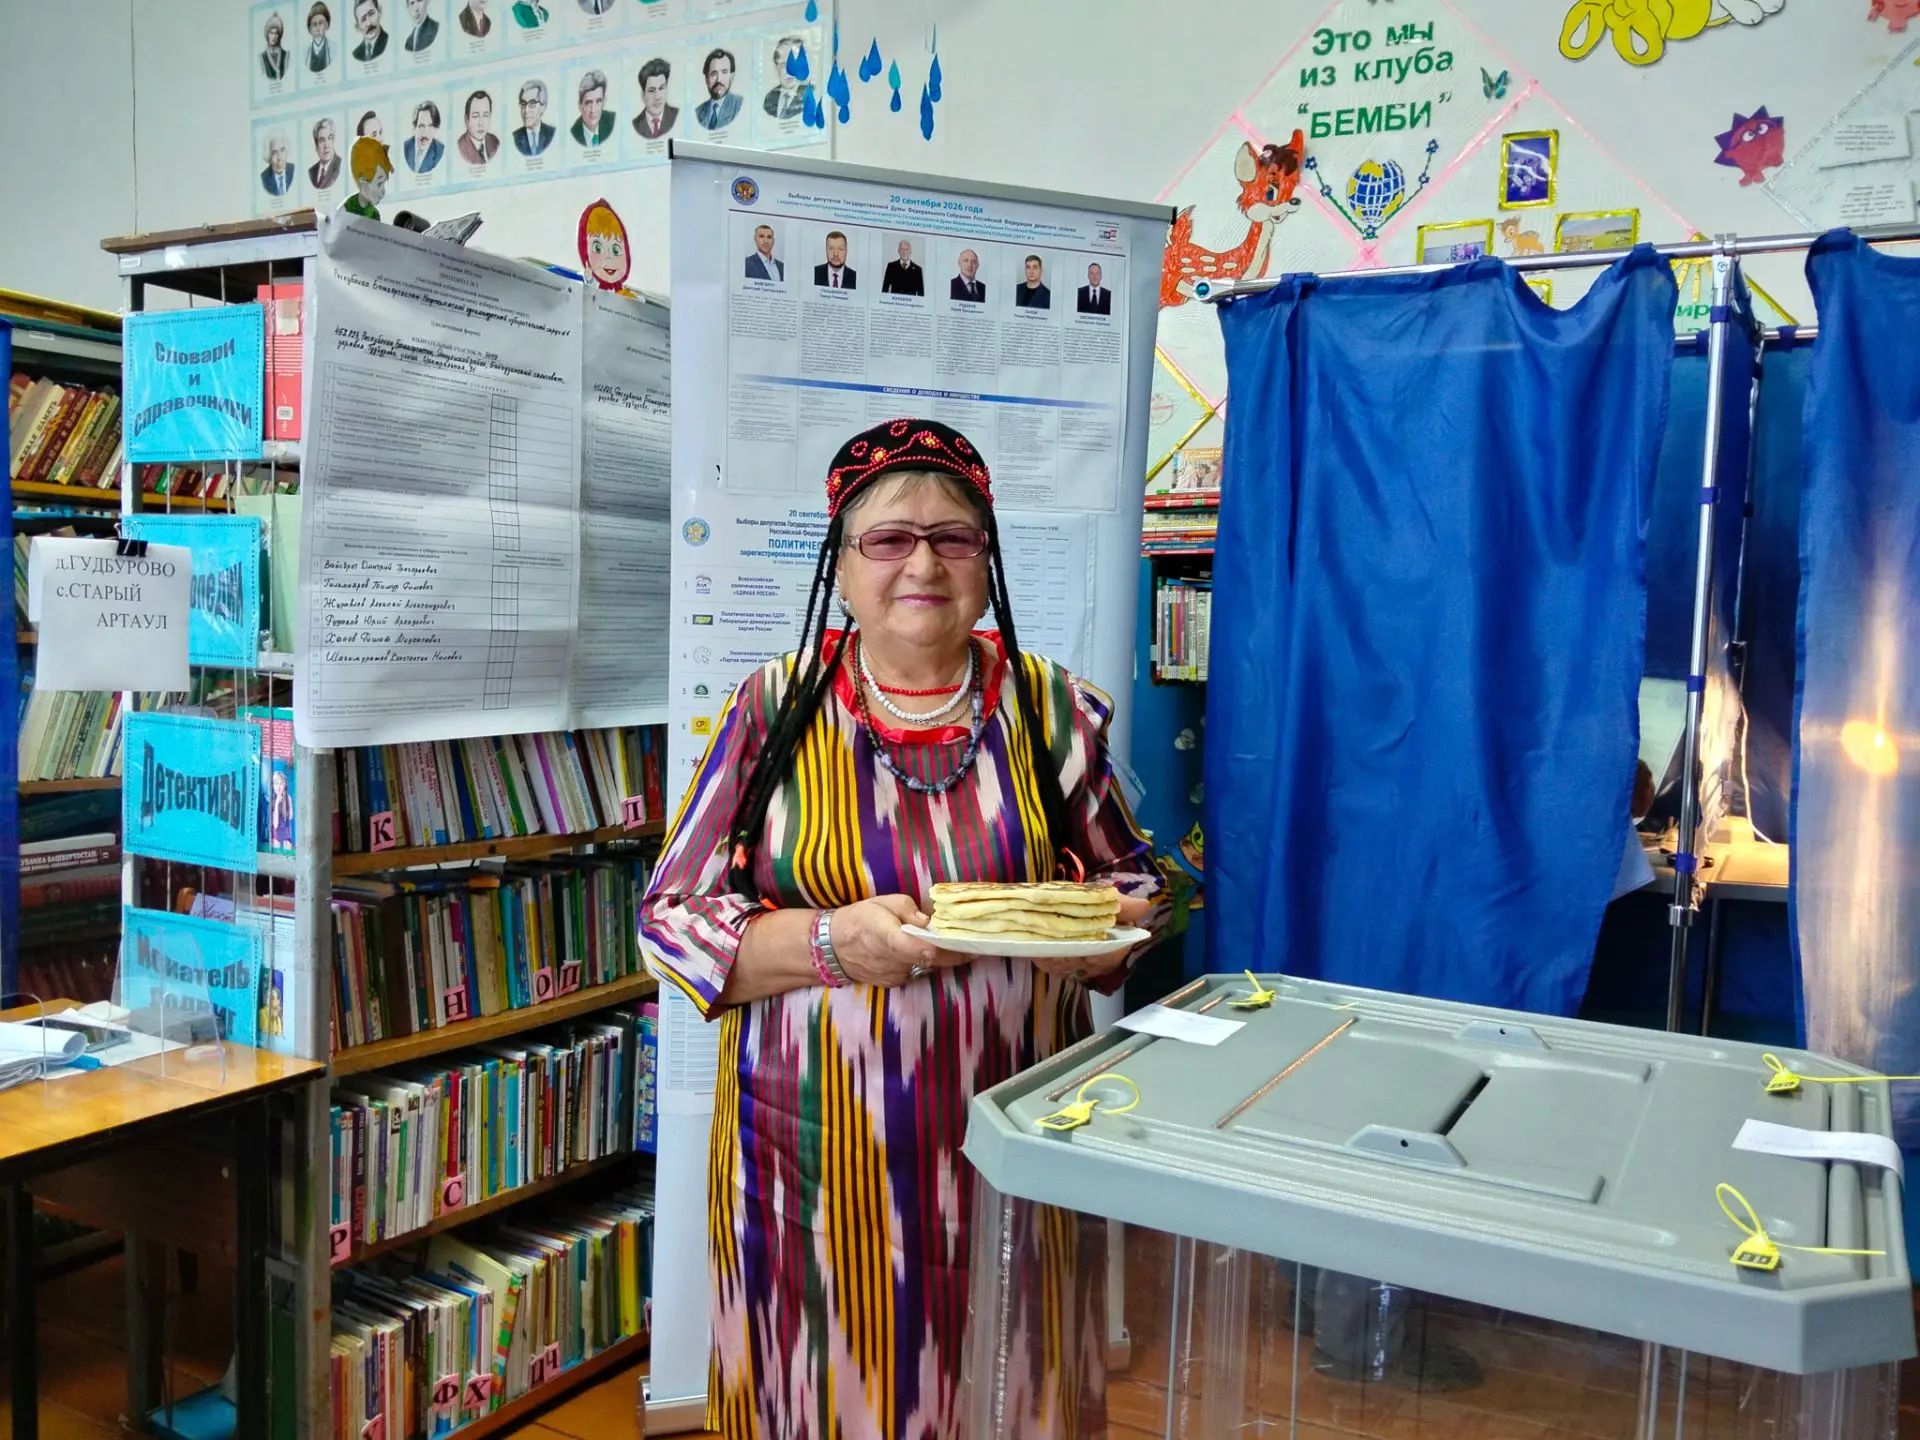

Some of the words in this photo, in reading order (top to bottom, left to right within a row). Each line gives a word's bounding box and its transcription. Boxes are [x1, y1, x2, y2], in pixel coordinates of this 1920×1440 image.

[1312, 28, 1372, 56] Это
[1386, 21, 1434, 46] мы
[1300, 66, 1336, 88] из
[1354, 46, 1453, 84] клуба
[788, 192, 812, 201] Выборы
[813, 196, 842, 205] депутатов
[843, 199, 889, 211] Государственной
[890, 204, 906, 213] Думы
[907, 207, 946, 217] Федерального
[946, 210, 972, 220] Собрания
[973, 214, 1002, 225] Российской
[1004, 218, 1033, 228] Федерации
[889, 194, 900, 203] 20
[902, 196, 941, 209] сентября
[943, 201, 963, 211] 2026
[964, 204, 984, 214] года
[155, 338, 235, 365] Словари
[189, 374, 200, 386] и
[37, 400, 58, 432] ПАМЯТЬ
[134, 396, 252, 437] справочники
[736, 518, 759, 527] Выборы
[760, 520, 786, 528] депутатов
[787, 520, 829, 529] Государственн
[788, 509, 797, 518] 20
[770, 528, 801, 537] Российской
[768, 538, 822, 551] ПОЛИТИЧЕС
[56, 555, 176, 578] д.ГУДБУРОВО
[361, 560, 392, 572] Дмитрий
[56, 583, 141, 602] с.СТАРЫЙ
[190, 561, 245, 627] опедии
[372, 580, 399, 592] Тимур
[369, 597, 402, 608] Алексей
[405, 599, 455, 611] Александрович
[96, 612, 168, 630] АРТАУЛ
[363, 615, 388, 626] Юрий
[325, 632, 358, 644] Ханов
[139, 741, 248, 838] Детективы
[624, 799, 642, 825] Л
[373, 819, 394, 847] К
[20, 856, 46, 867] УБЛИКА
[536, 972, 551, 996] О
[561, 965, 580, 990] П
[446, 989, 466, 1020] Н
[444, 1181, 462, 1208] С
[330, 1229, 347, 1258] Р
[434, 1381, 459, 1404] Ф
[464, 1379, 490, 1407] Х
